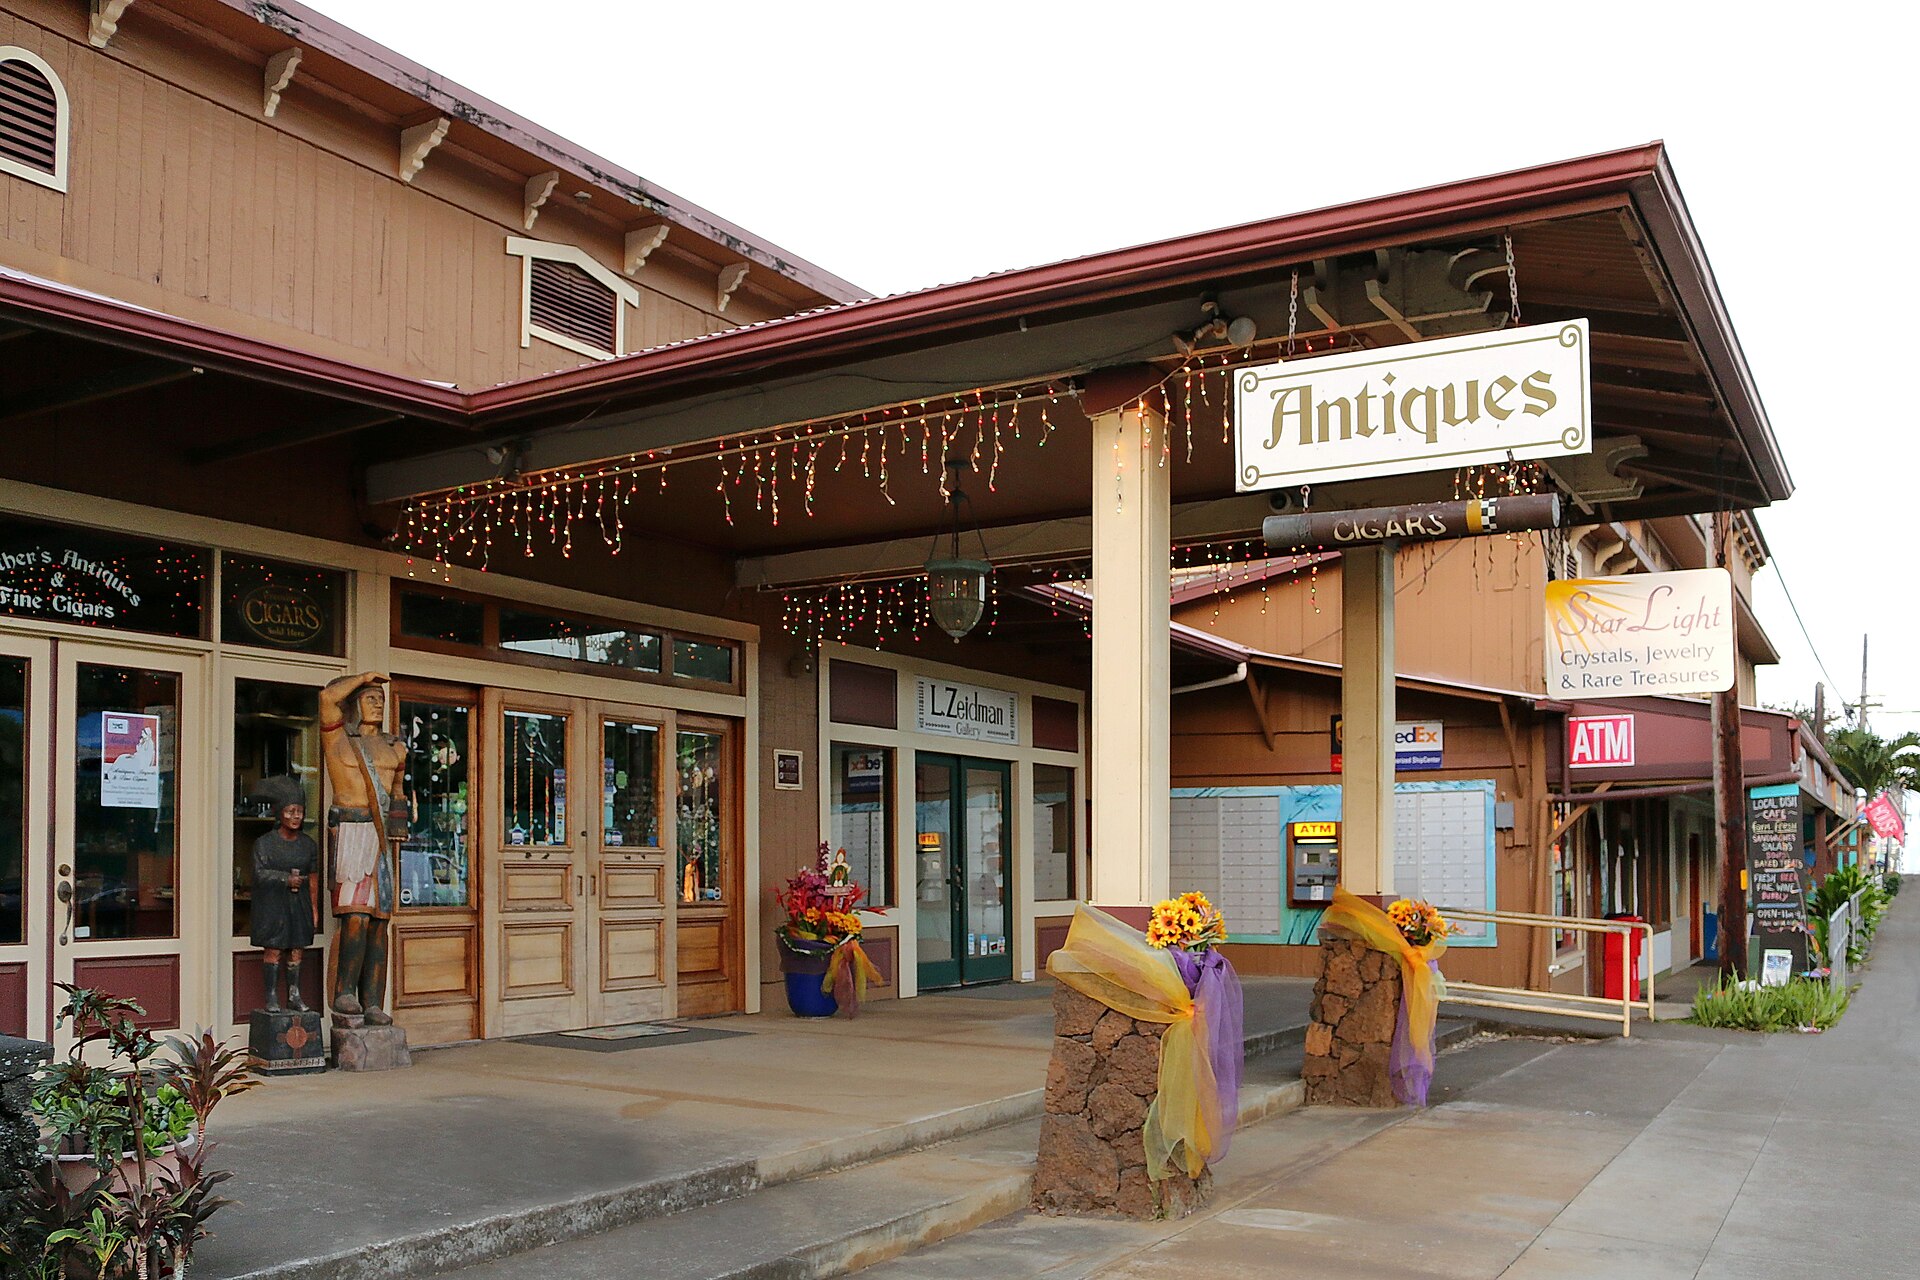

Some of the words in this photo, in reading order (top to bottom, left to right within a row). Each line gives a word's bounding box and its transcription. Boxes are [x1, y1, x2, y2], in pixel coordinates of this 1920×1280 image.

[1263, 370, 1557, 449] Antiques
[1333, 513, 1447, 542] CIGARS
[51, 571, 64, 588] &
[61, 549, 141, 607] Antiques
[0, 585, 43, 609] Fine
[52, 595, 115, 618] Cigars
[245, 599, 321, 630] CIGARS
[1560, 648, 1638, 669] Crystals,
[1646, 643, 1715, 665] Jewelry
[1561, 674, 1575, 689] &
[1582, 672, 1623, 689] Rare
[1630, 669, 1720, 686] Treasures
[1395, 726, 1438, 743] edEx
[1572, 721, 1628, 763] ATM
[1753, 798, 1778, 810] LOCAL
[1300, 824, 1332, 834] ATM
